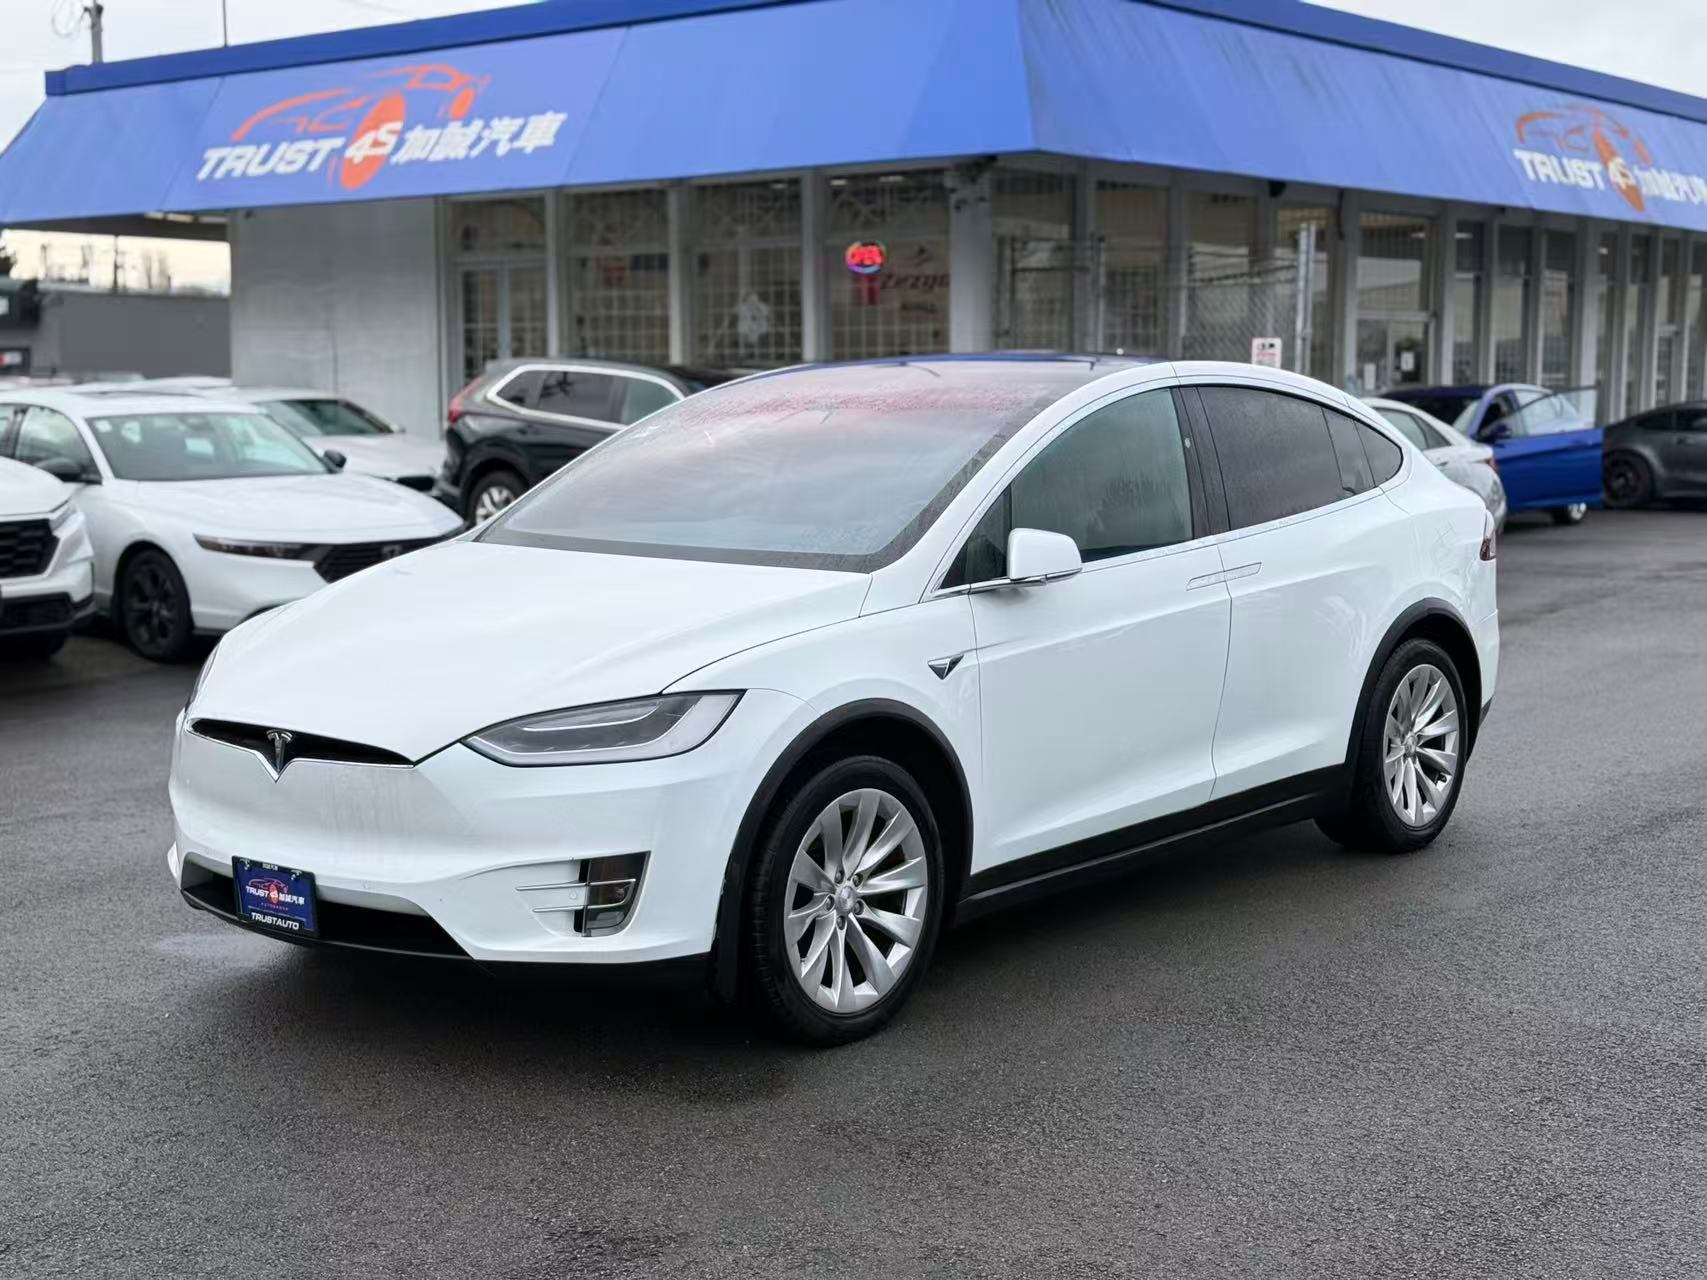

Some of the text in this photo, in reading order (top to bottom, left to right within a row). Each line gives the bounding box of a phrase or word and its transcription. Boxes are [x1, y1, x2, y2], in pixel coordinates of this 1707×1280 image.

[197, 136, 345, 181] TRUST
[343, 120, 404, 165] 4S
[1512, 147, 1606, 191] TRUST
[245, 885, 270, 898] TRUST
[251, 912, 300, 930] TRUSTAUTO
